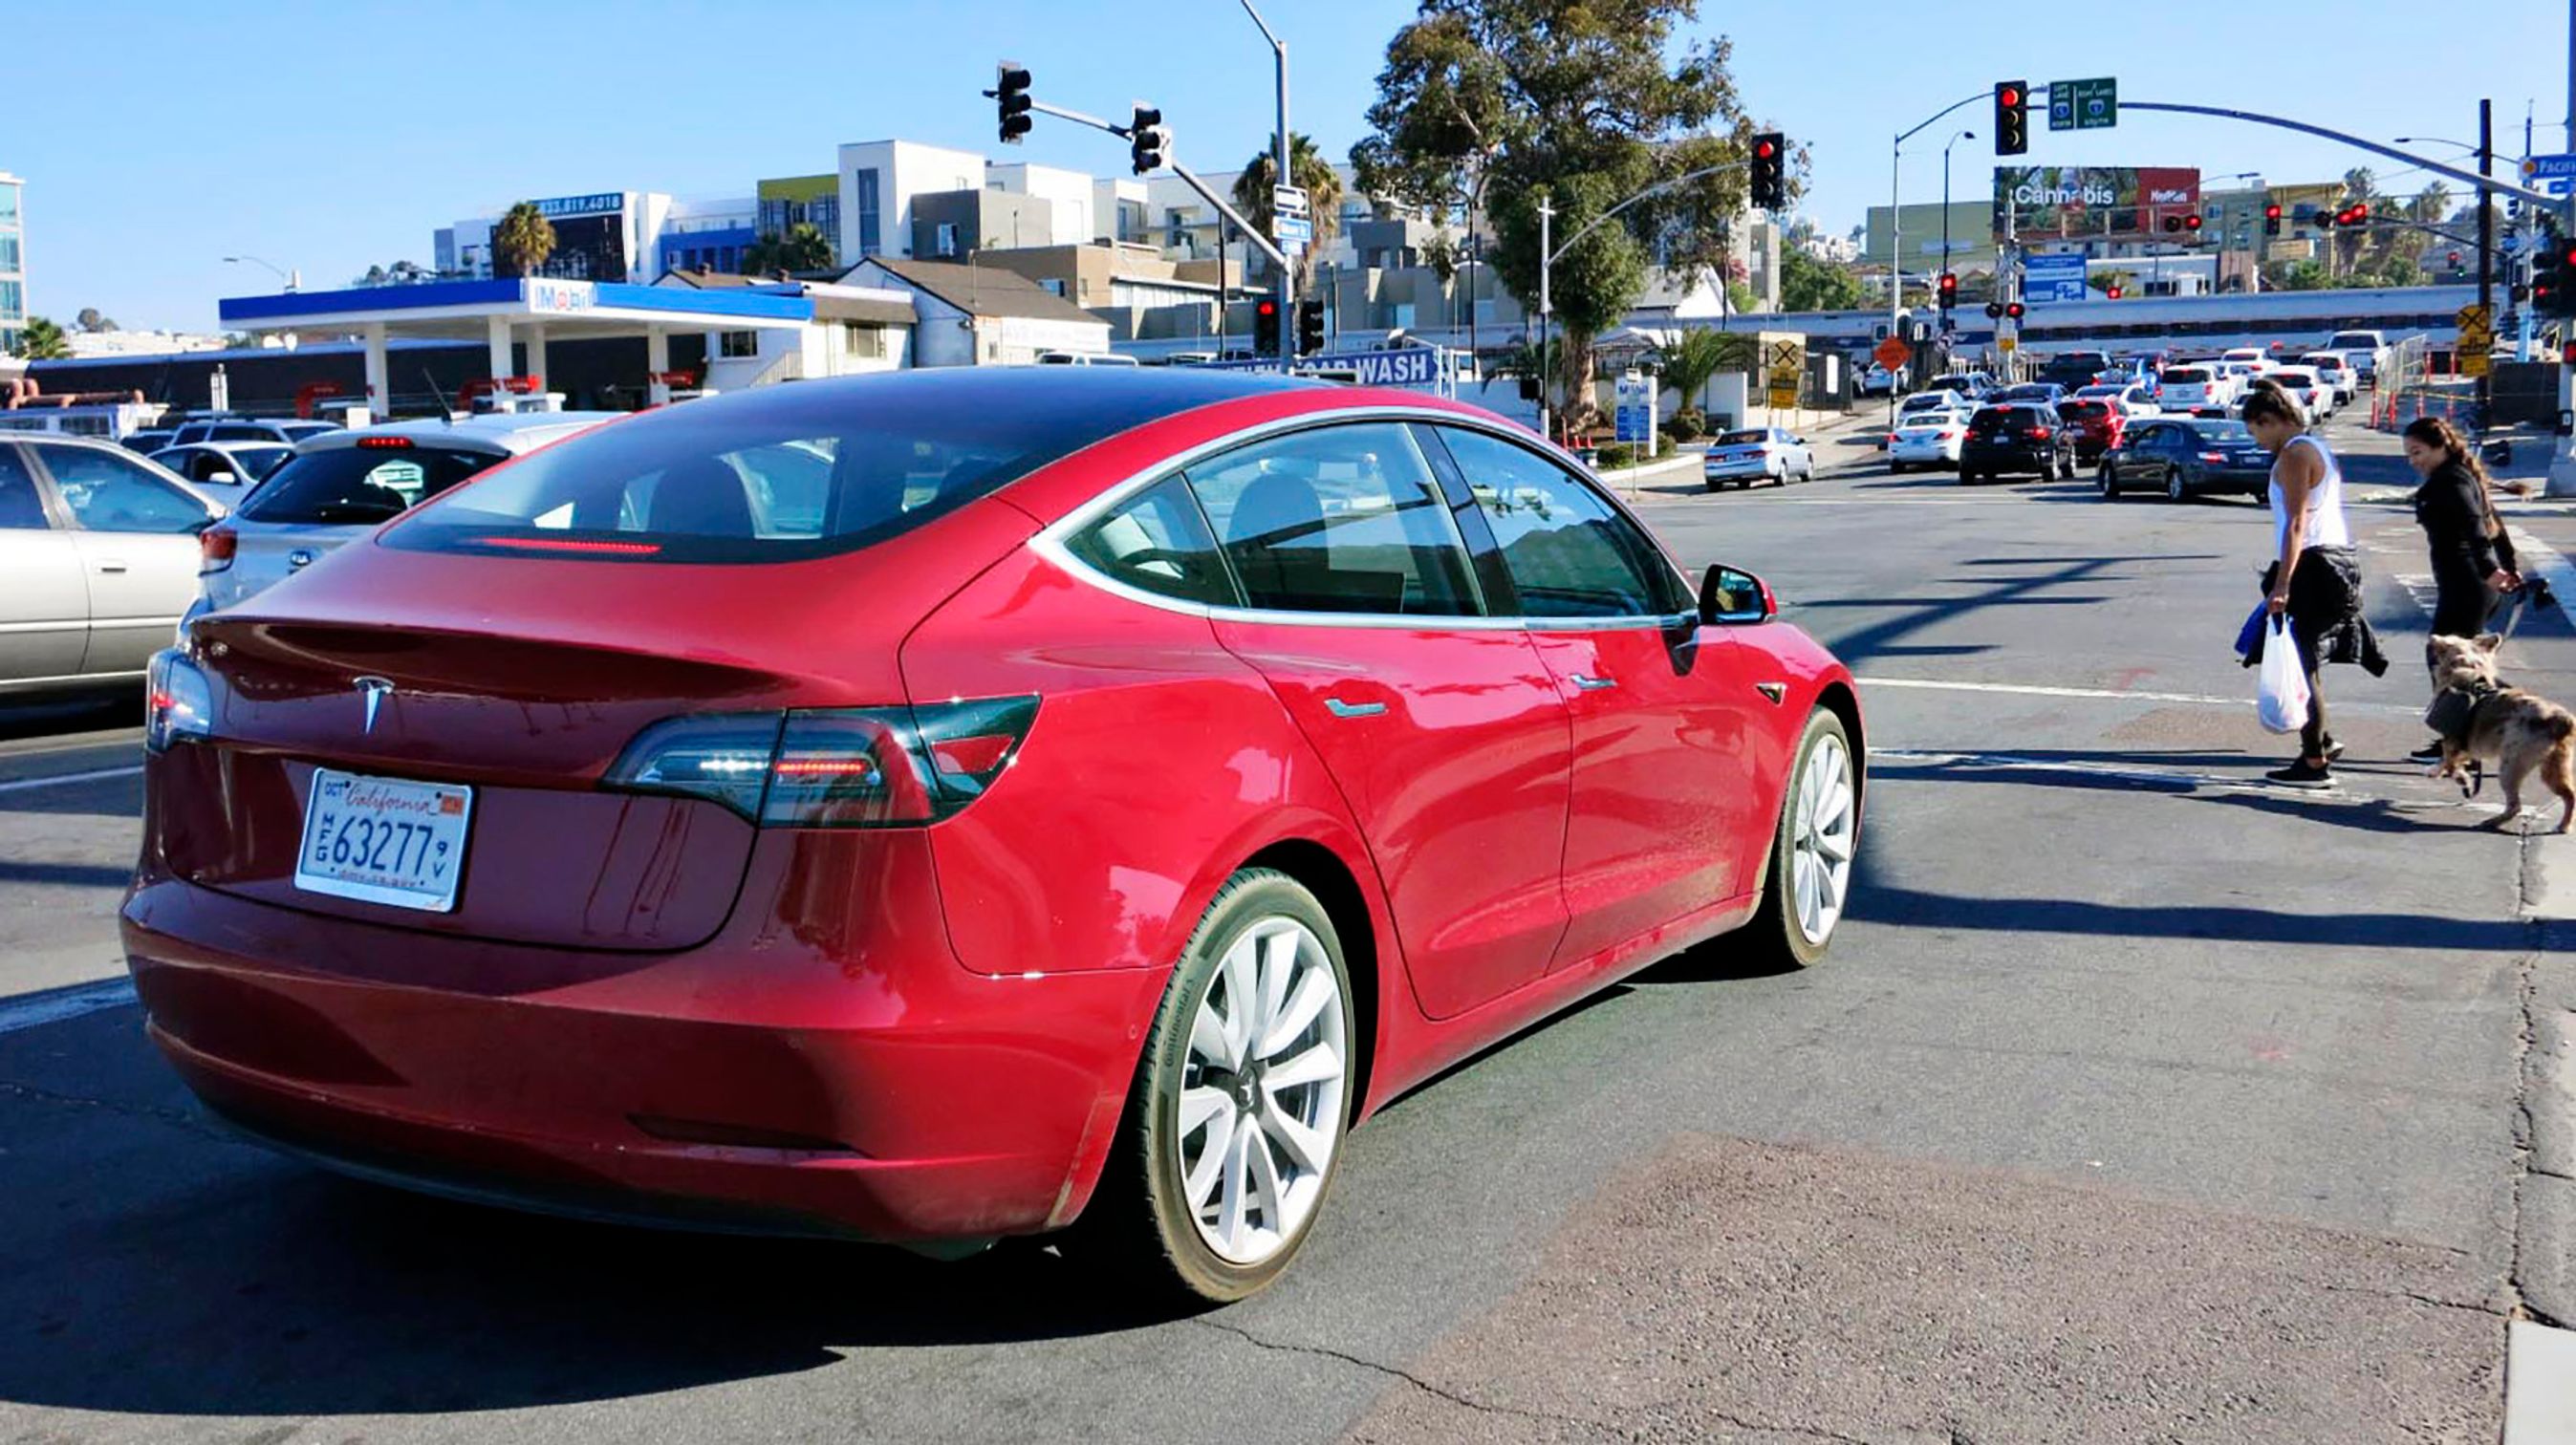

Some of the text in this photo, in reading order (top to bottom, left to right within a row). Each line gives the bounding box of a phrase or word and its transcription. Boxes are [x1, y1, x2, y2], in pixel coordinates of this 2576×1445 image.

[1356, 355, 1428, 384] WASH
[345, 782, 430, 816] California
[333, 815, 433, 876] 63277
